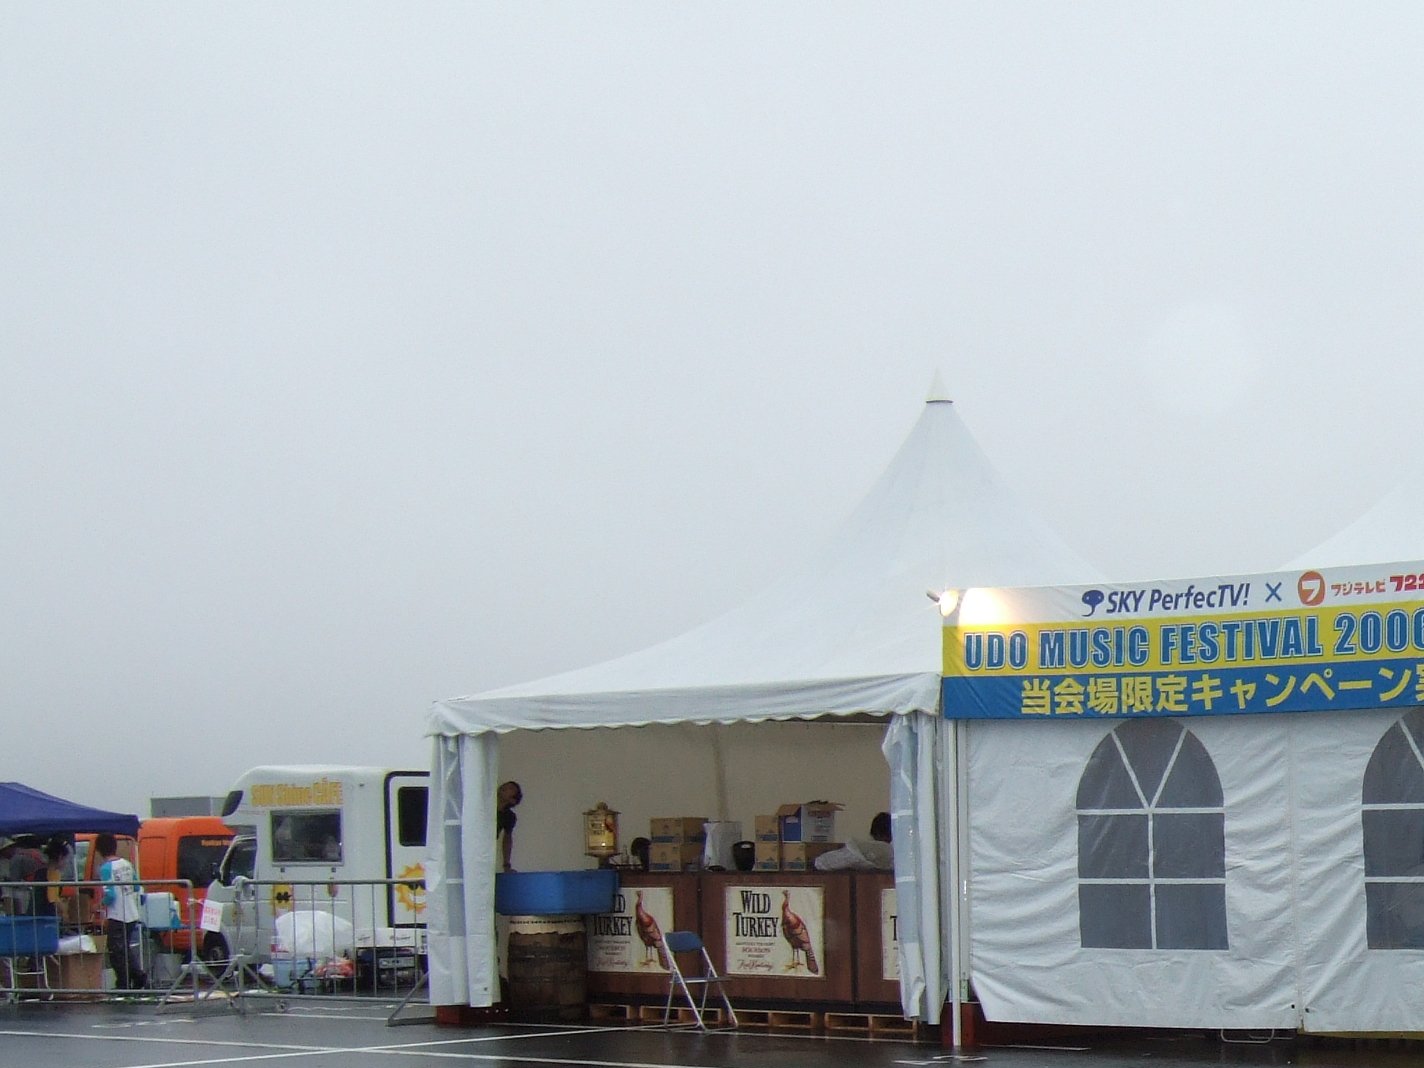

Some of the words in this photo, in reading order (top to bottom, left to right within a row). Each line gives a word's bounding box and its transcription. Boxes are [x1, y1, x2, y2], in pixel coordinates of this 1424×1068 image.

[1106, 590, 1147, 614] SKY
[1148, 582, 1251, 612] PerfecTV!
[964, 631, 1028, 670] UDO
[1038, 624, 1150, 669] MUSIC
[1159, 614, 1324, 666] FESTIVAL
[740, 889, 772, 914] WILD
[732, 912, 779, 938] TURKEY
